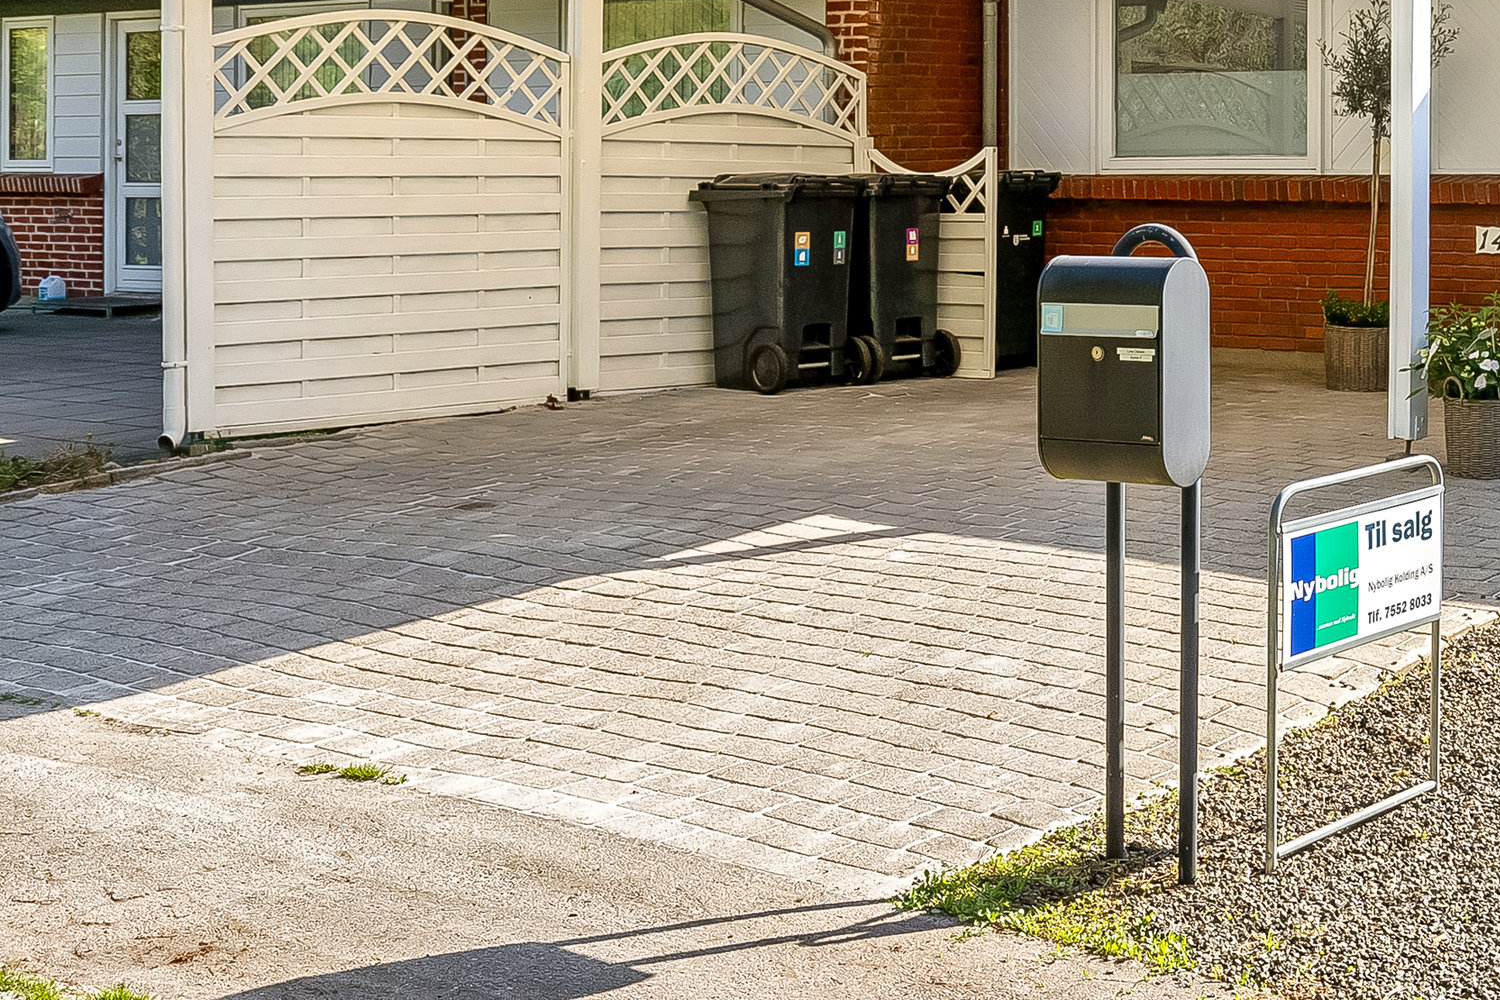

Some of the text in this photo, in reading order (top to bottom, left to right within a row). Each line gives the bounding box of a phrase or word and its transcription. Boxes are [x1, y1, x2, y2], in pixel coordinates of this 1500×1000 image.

[1365, 509, 1433, 550] Til salg
[1290, 566, 1360, 602] Nybolig
[1368, 576, 1393, 592] Nybolig
[1420, 563, 1434, 576] A/S
[1368, 608, 1382, 624] Tlf.
[1385, 600, 1407, 618] 7552
[1409, 592, 1432, 611] 8033
